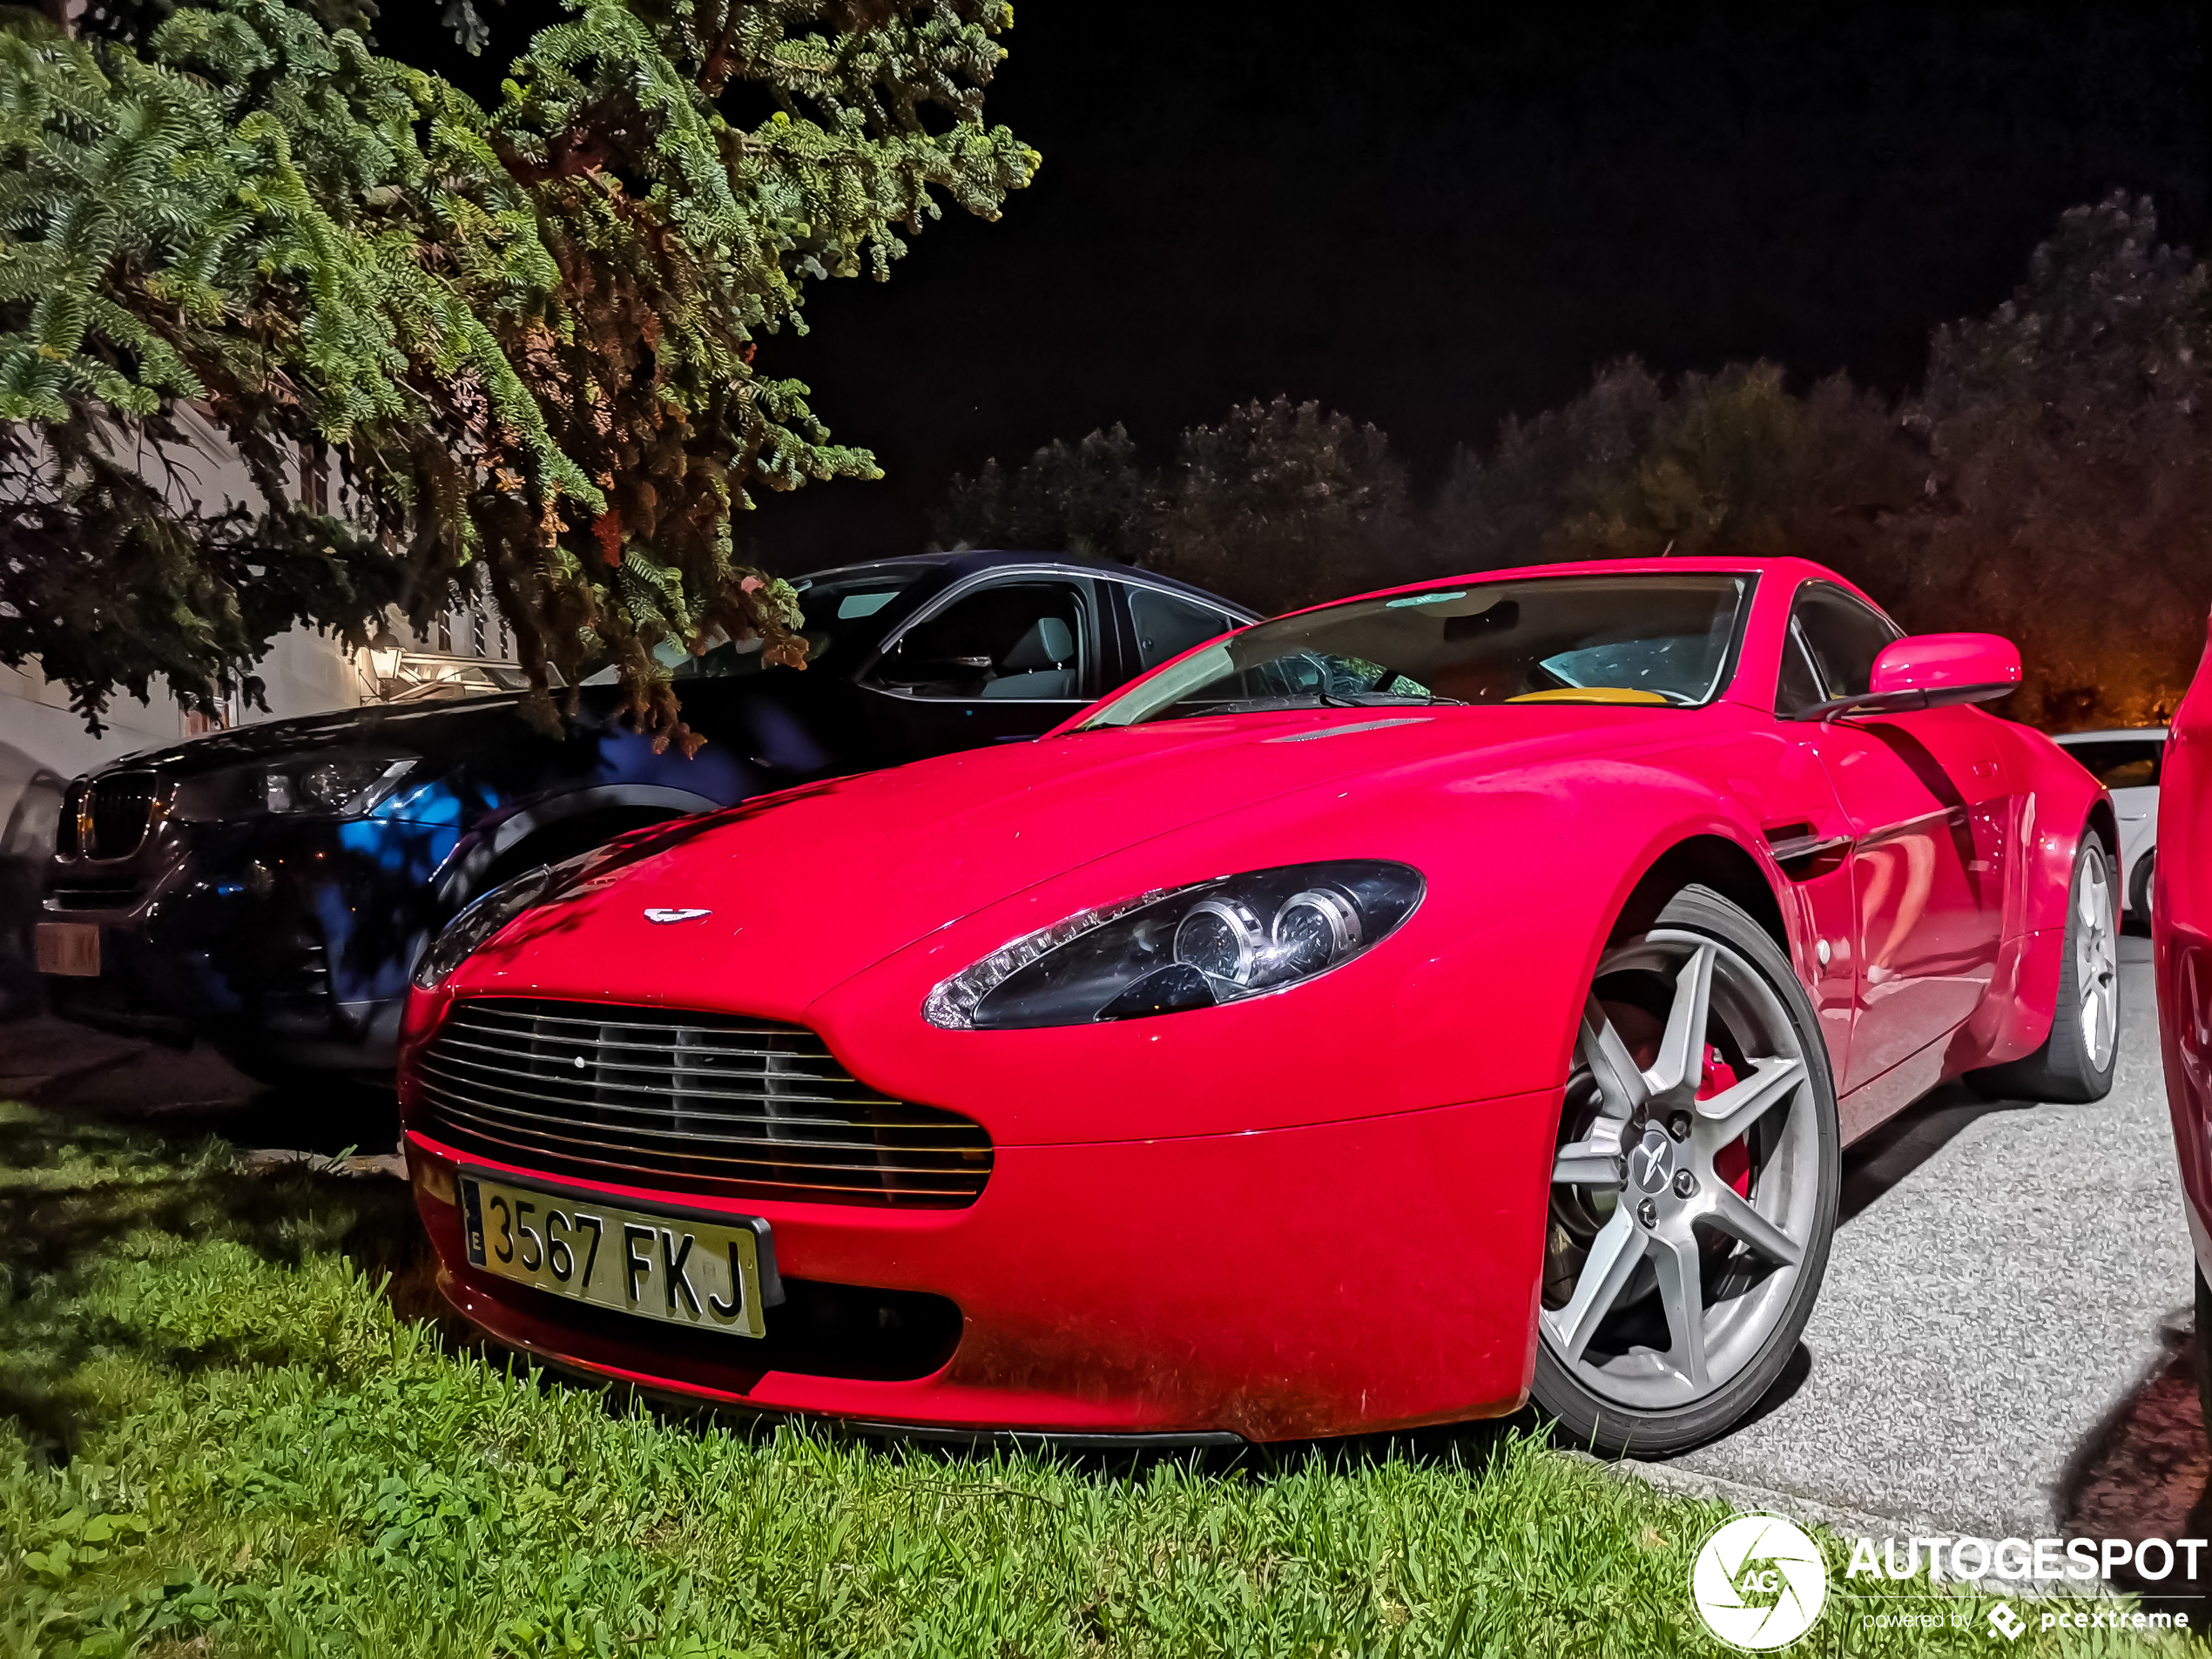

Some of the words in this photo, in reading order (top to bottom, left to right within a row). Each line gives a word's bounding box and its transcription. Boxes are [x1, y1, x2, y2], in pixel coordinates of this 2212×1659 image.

[471, 1231, 482, 1251] E
[489, 1195, 603, 1289] 3567
[624, 1222, 745, 1318] FKJ
